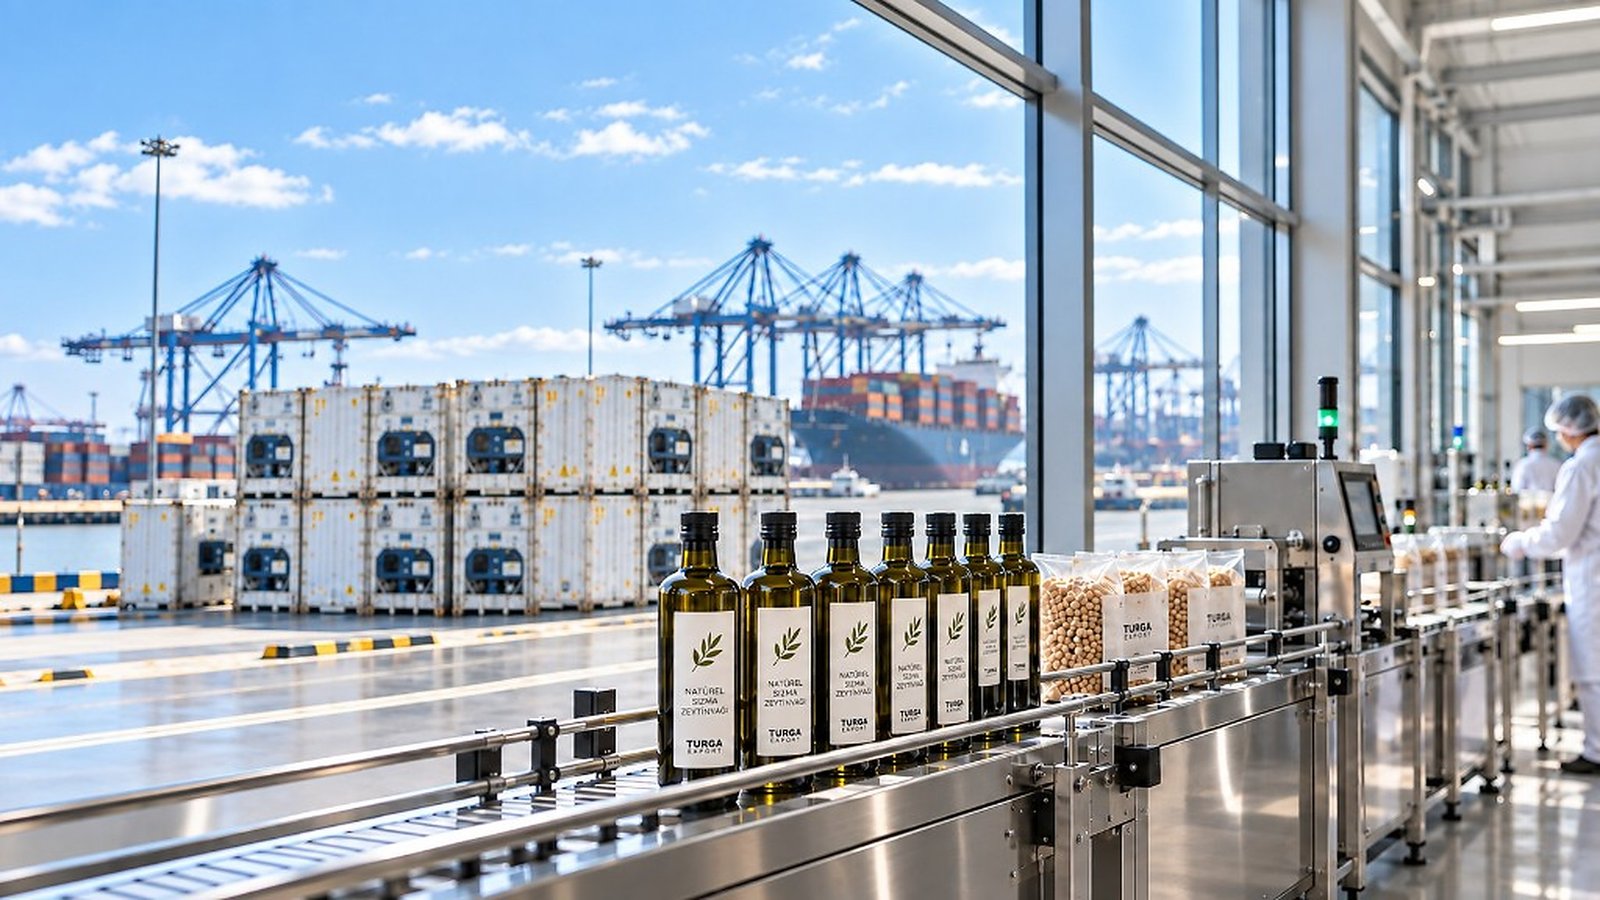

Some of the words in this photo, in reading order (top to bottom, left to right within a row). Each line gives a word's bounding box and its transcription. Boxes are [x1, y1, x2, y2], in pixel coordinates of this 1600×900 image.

[1123, 622, 1152, 633] TURGA
[692, 697, 718, 706] SIZMA
[841, 718, 868, 727] TURGA
[768, 728, 802, 737] TURGA
[686, 739, 723, 748] TURGA
